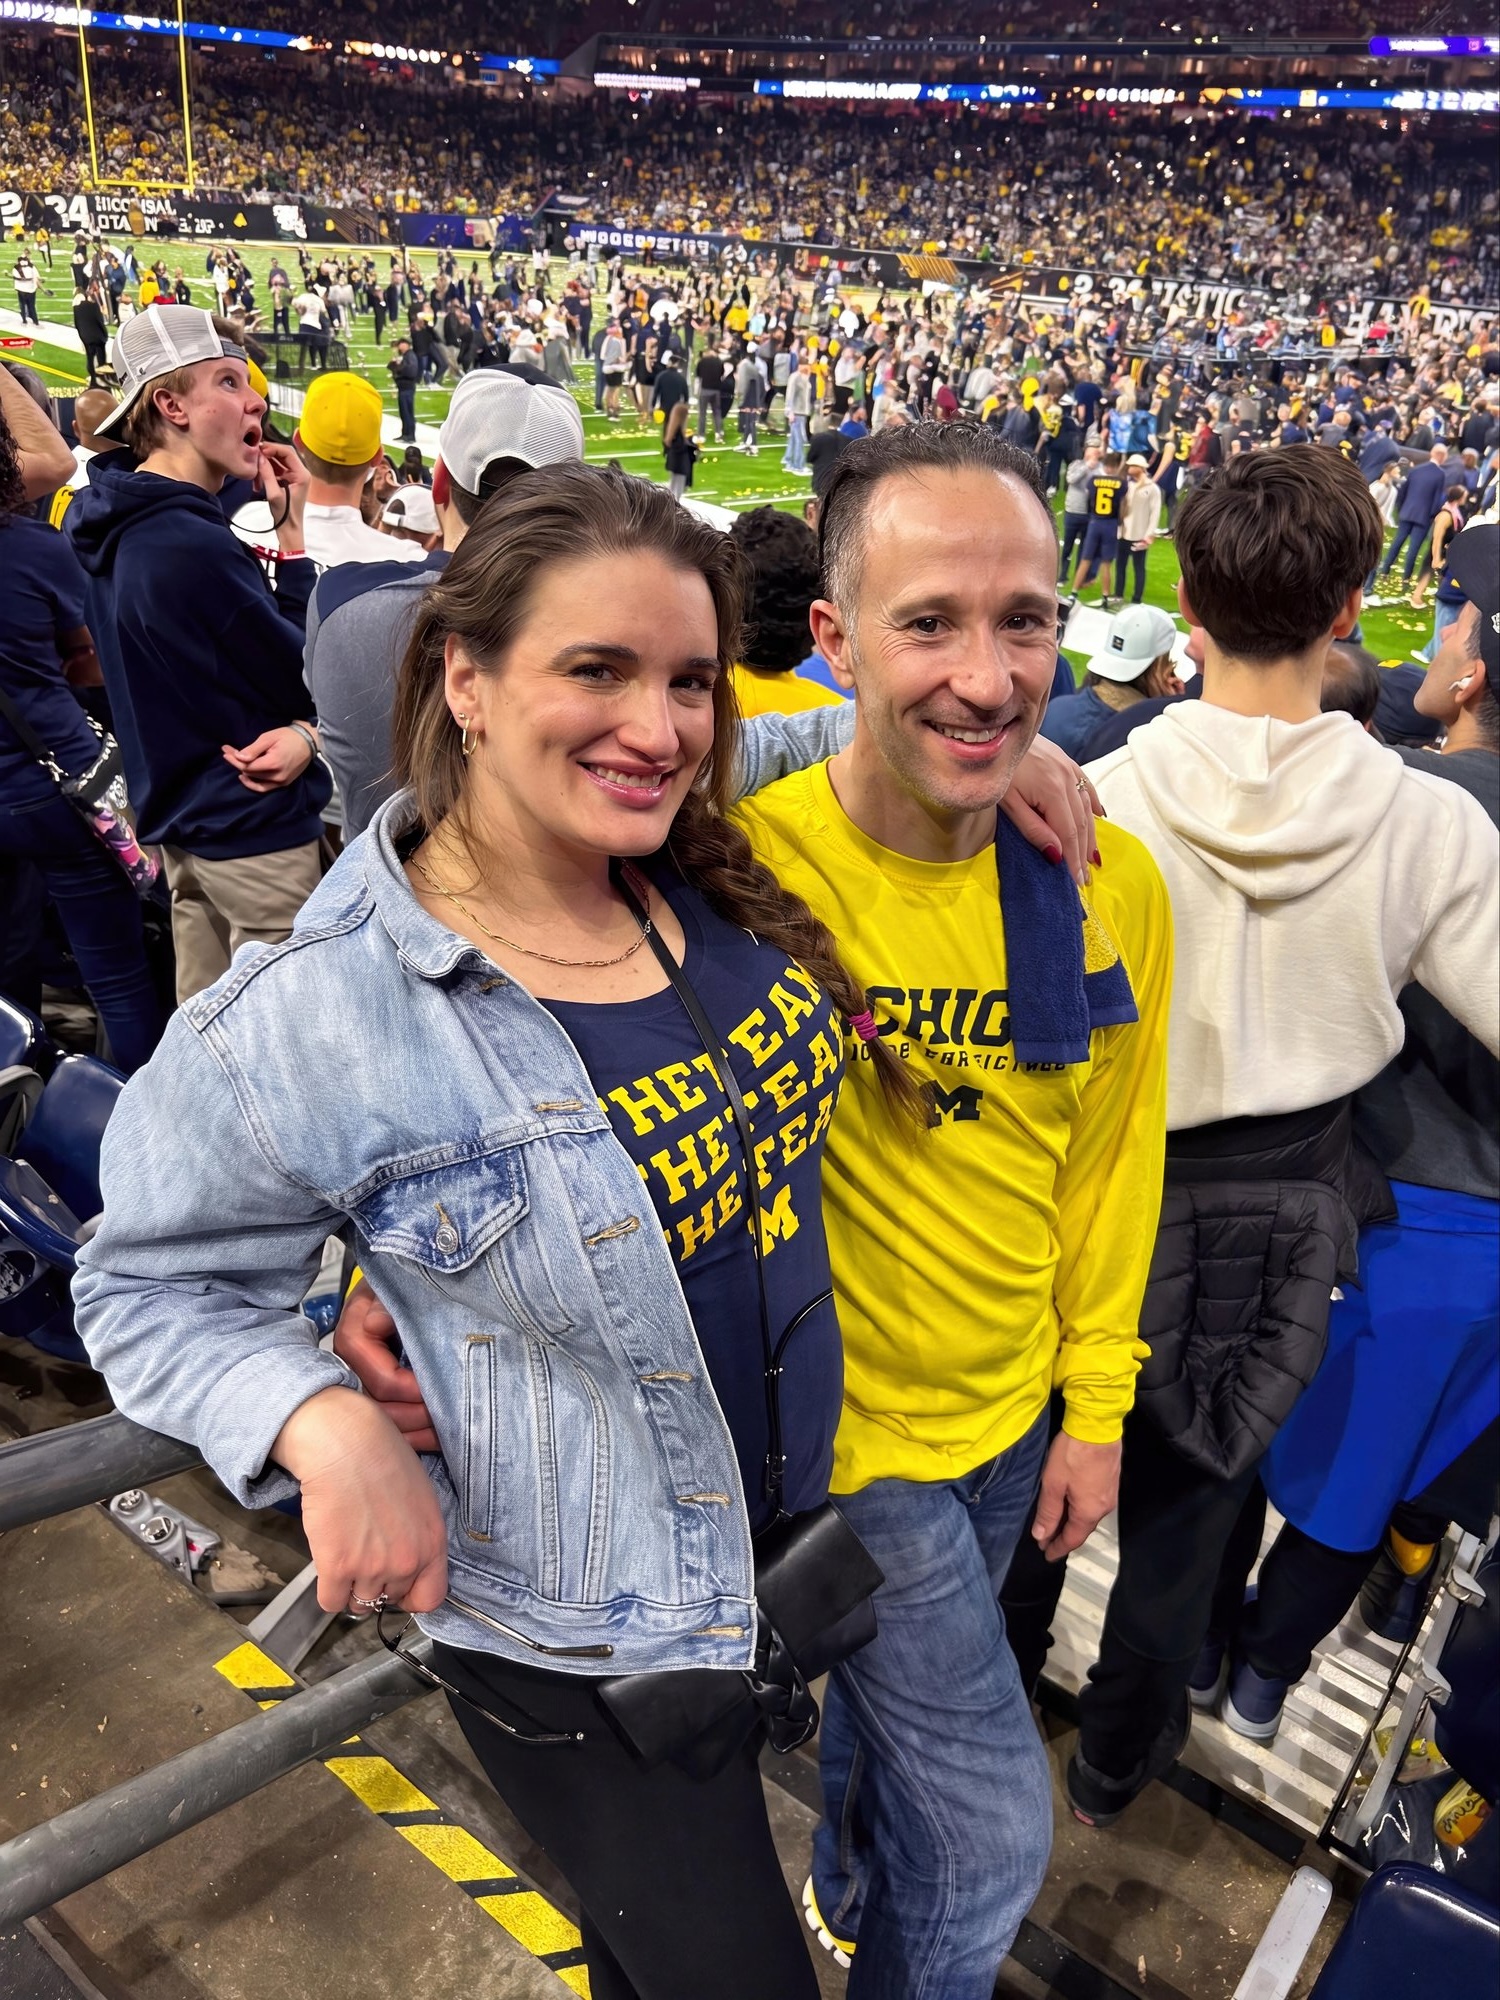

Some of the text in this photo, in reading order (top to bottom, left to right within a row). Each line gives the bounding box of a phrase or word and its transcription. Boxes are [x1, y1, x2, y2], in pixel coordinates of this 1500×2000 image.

[1095, 487, 1115, 515] 6
[840, 985, 1012, 1047] CHIG
[597, 1061, 708, 1137] HE
[919, 1079, 983, 1129] M
[636, 1115, 730, 1205] HE
[663, 1170, 743, 1262] HE
[747, 1184, 800, 1257] M
